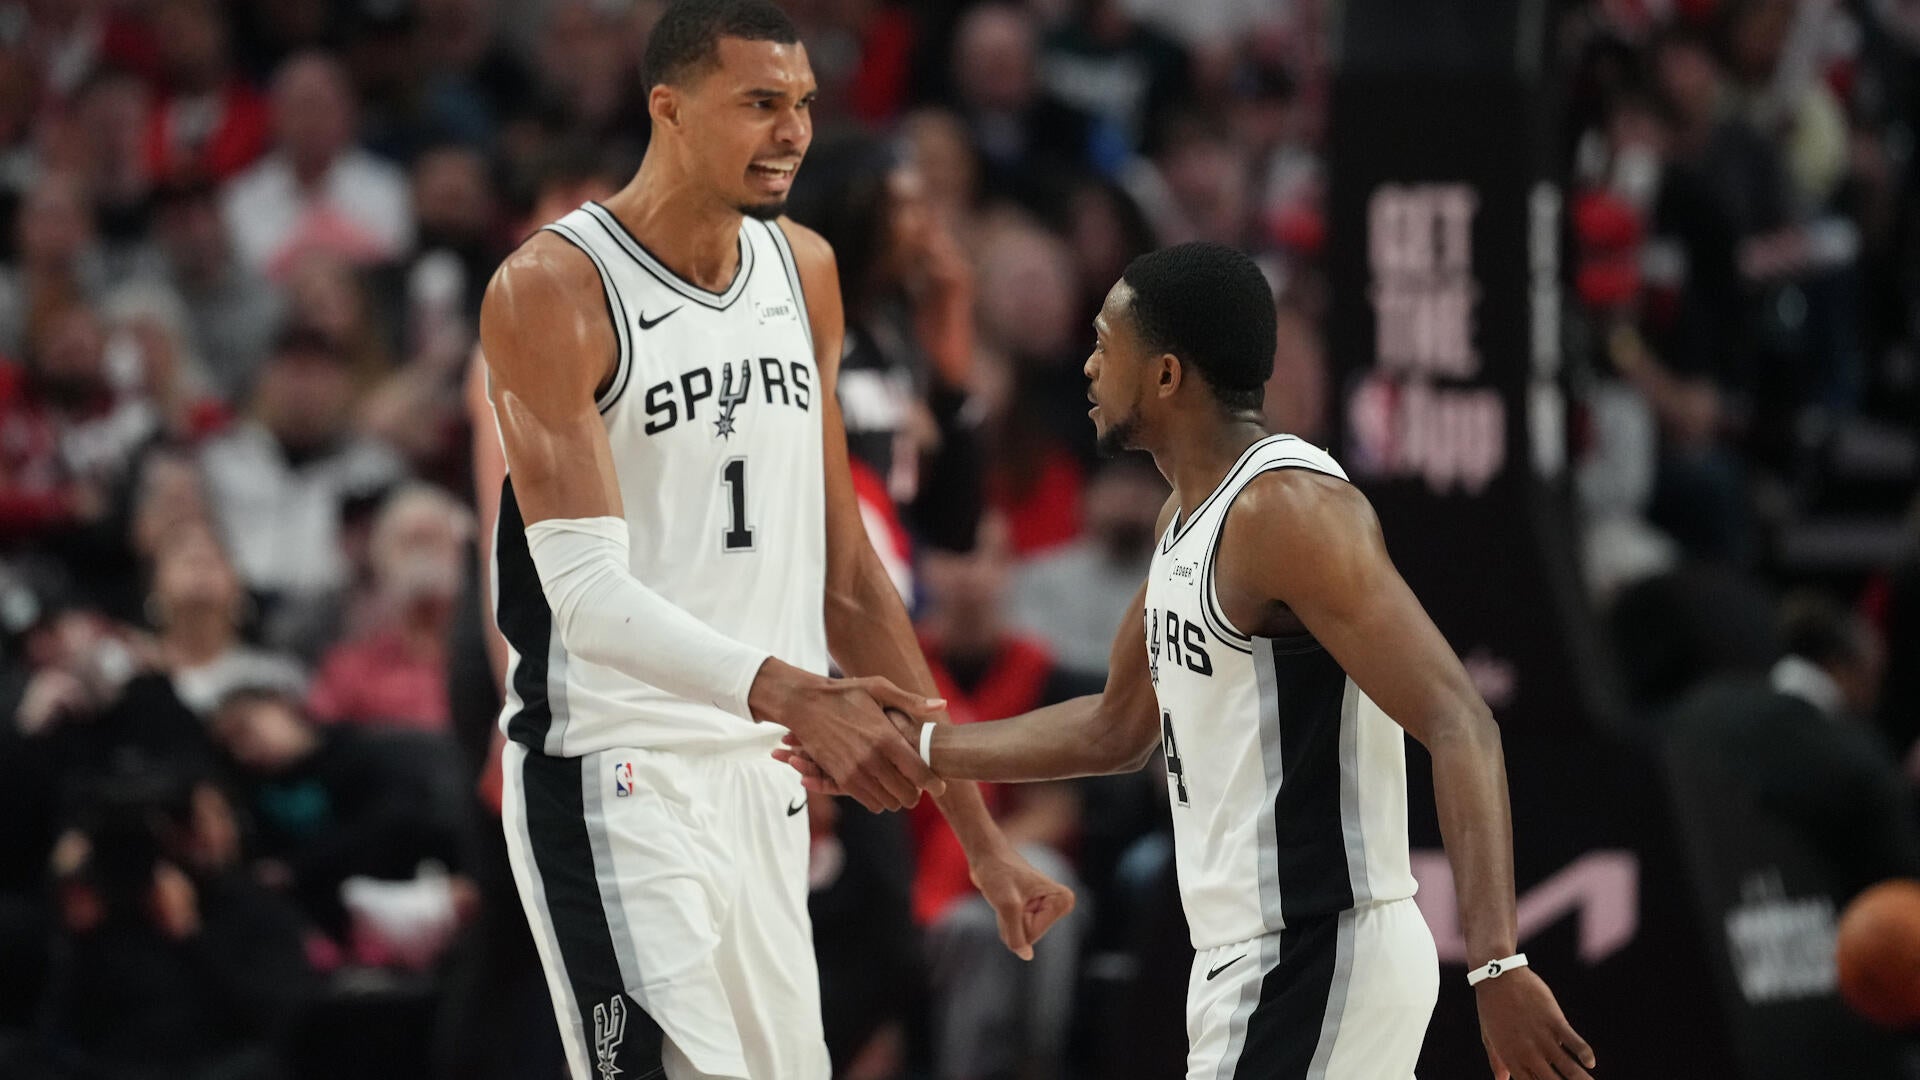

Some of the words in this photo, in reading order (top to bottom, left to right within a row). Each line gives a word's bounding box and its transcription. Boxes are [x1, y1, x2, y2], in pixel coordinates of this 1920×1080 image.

[645, 358, 811, 441] SPURS
[719, 455, 757, 553] 1
[1172, 564, 1193, 578] LEDGER
[1143, 608, 1214, 687] URS
[1162, 707, 1191, 809] 4
